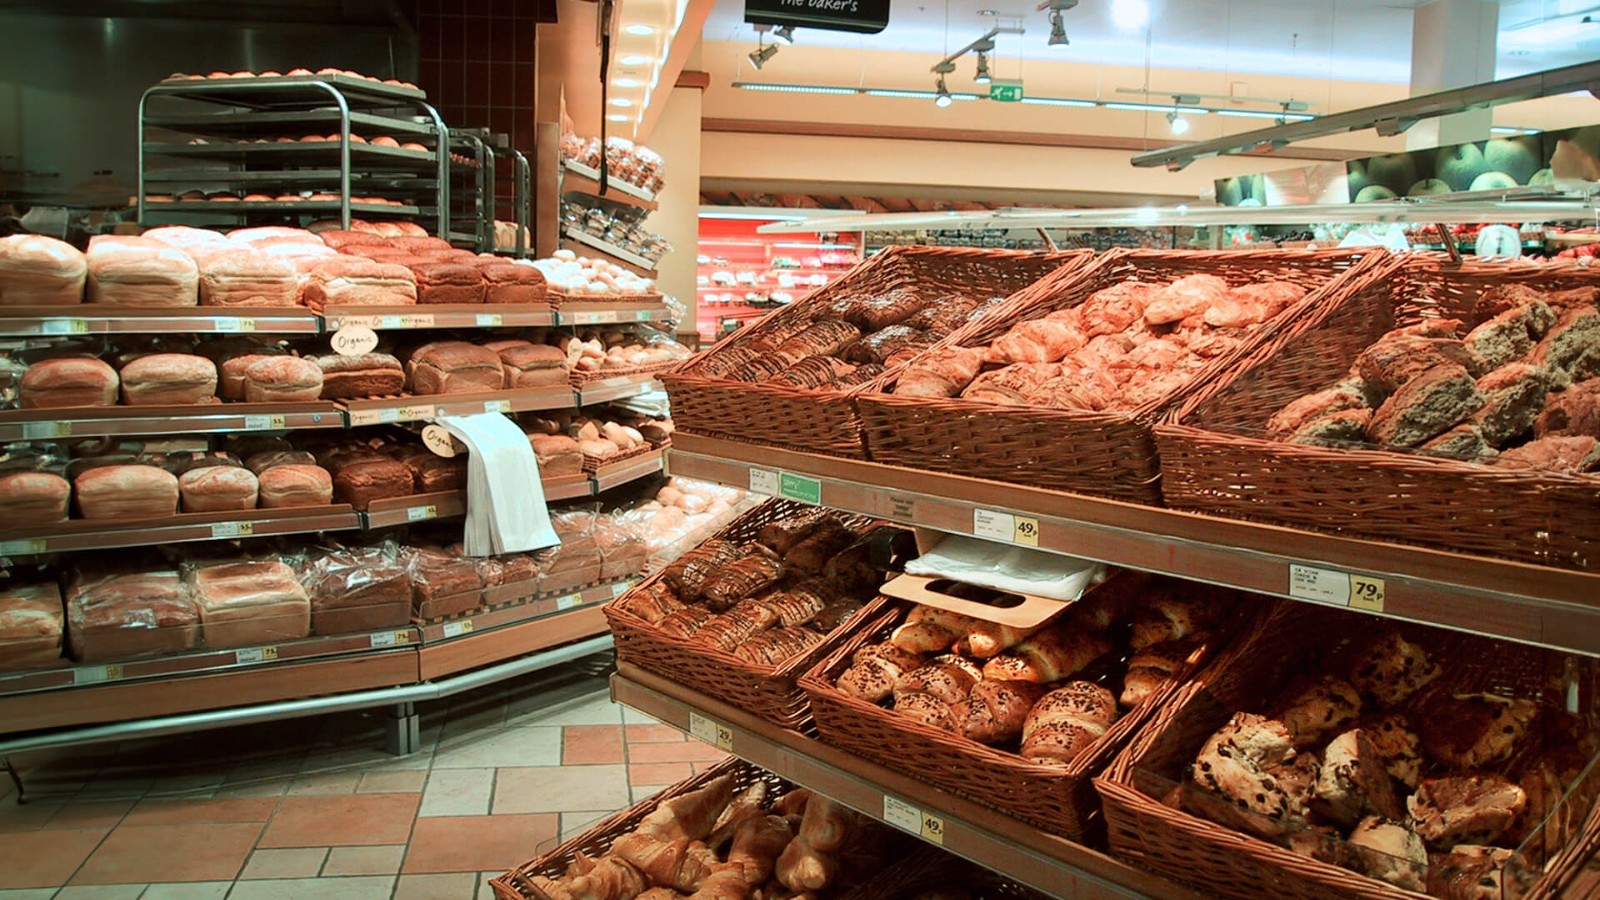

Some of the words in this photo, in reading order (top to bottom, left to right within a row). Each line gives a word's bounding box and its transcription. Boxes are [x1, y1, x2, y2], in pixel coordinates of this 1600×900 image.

[338, 335, 373, 349] Organic
[1018, 521, 1037, 537] 49p
[1356, 581, 1384, 601] 79p
